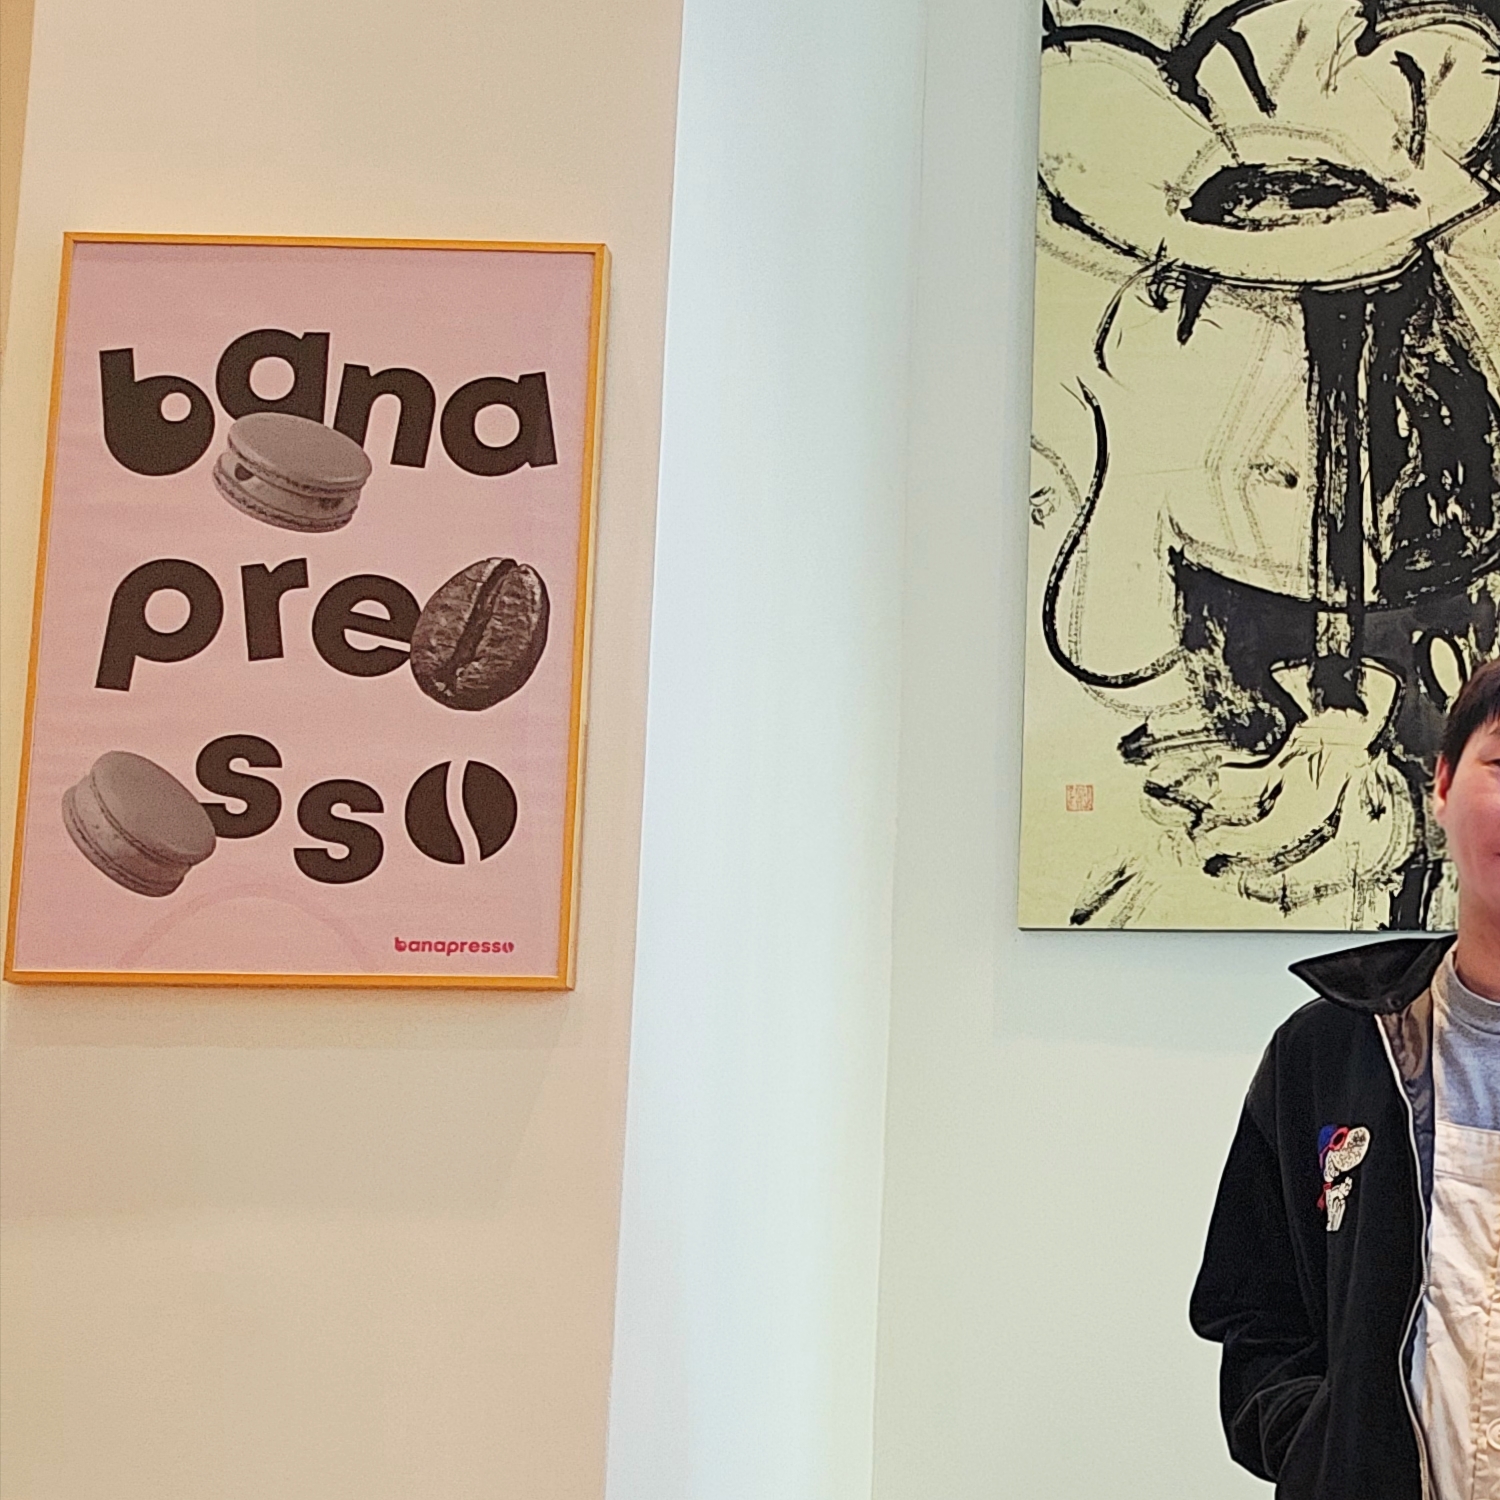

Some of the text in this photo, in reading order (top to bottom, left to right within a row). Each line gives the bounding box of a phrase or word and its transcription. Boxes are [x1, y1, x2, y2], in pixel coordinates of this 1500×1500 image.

[98, 327, 559, 477] bana
[95, 557, 423, 692] pre
[394, 936, 515, 956] banapresso
